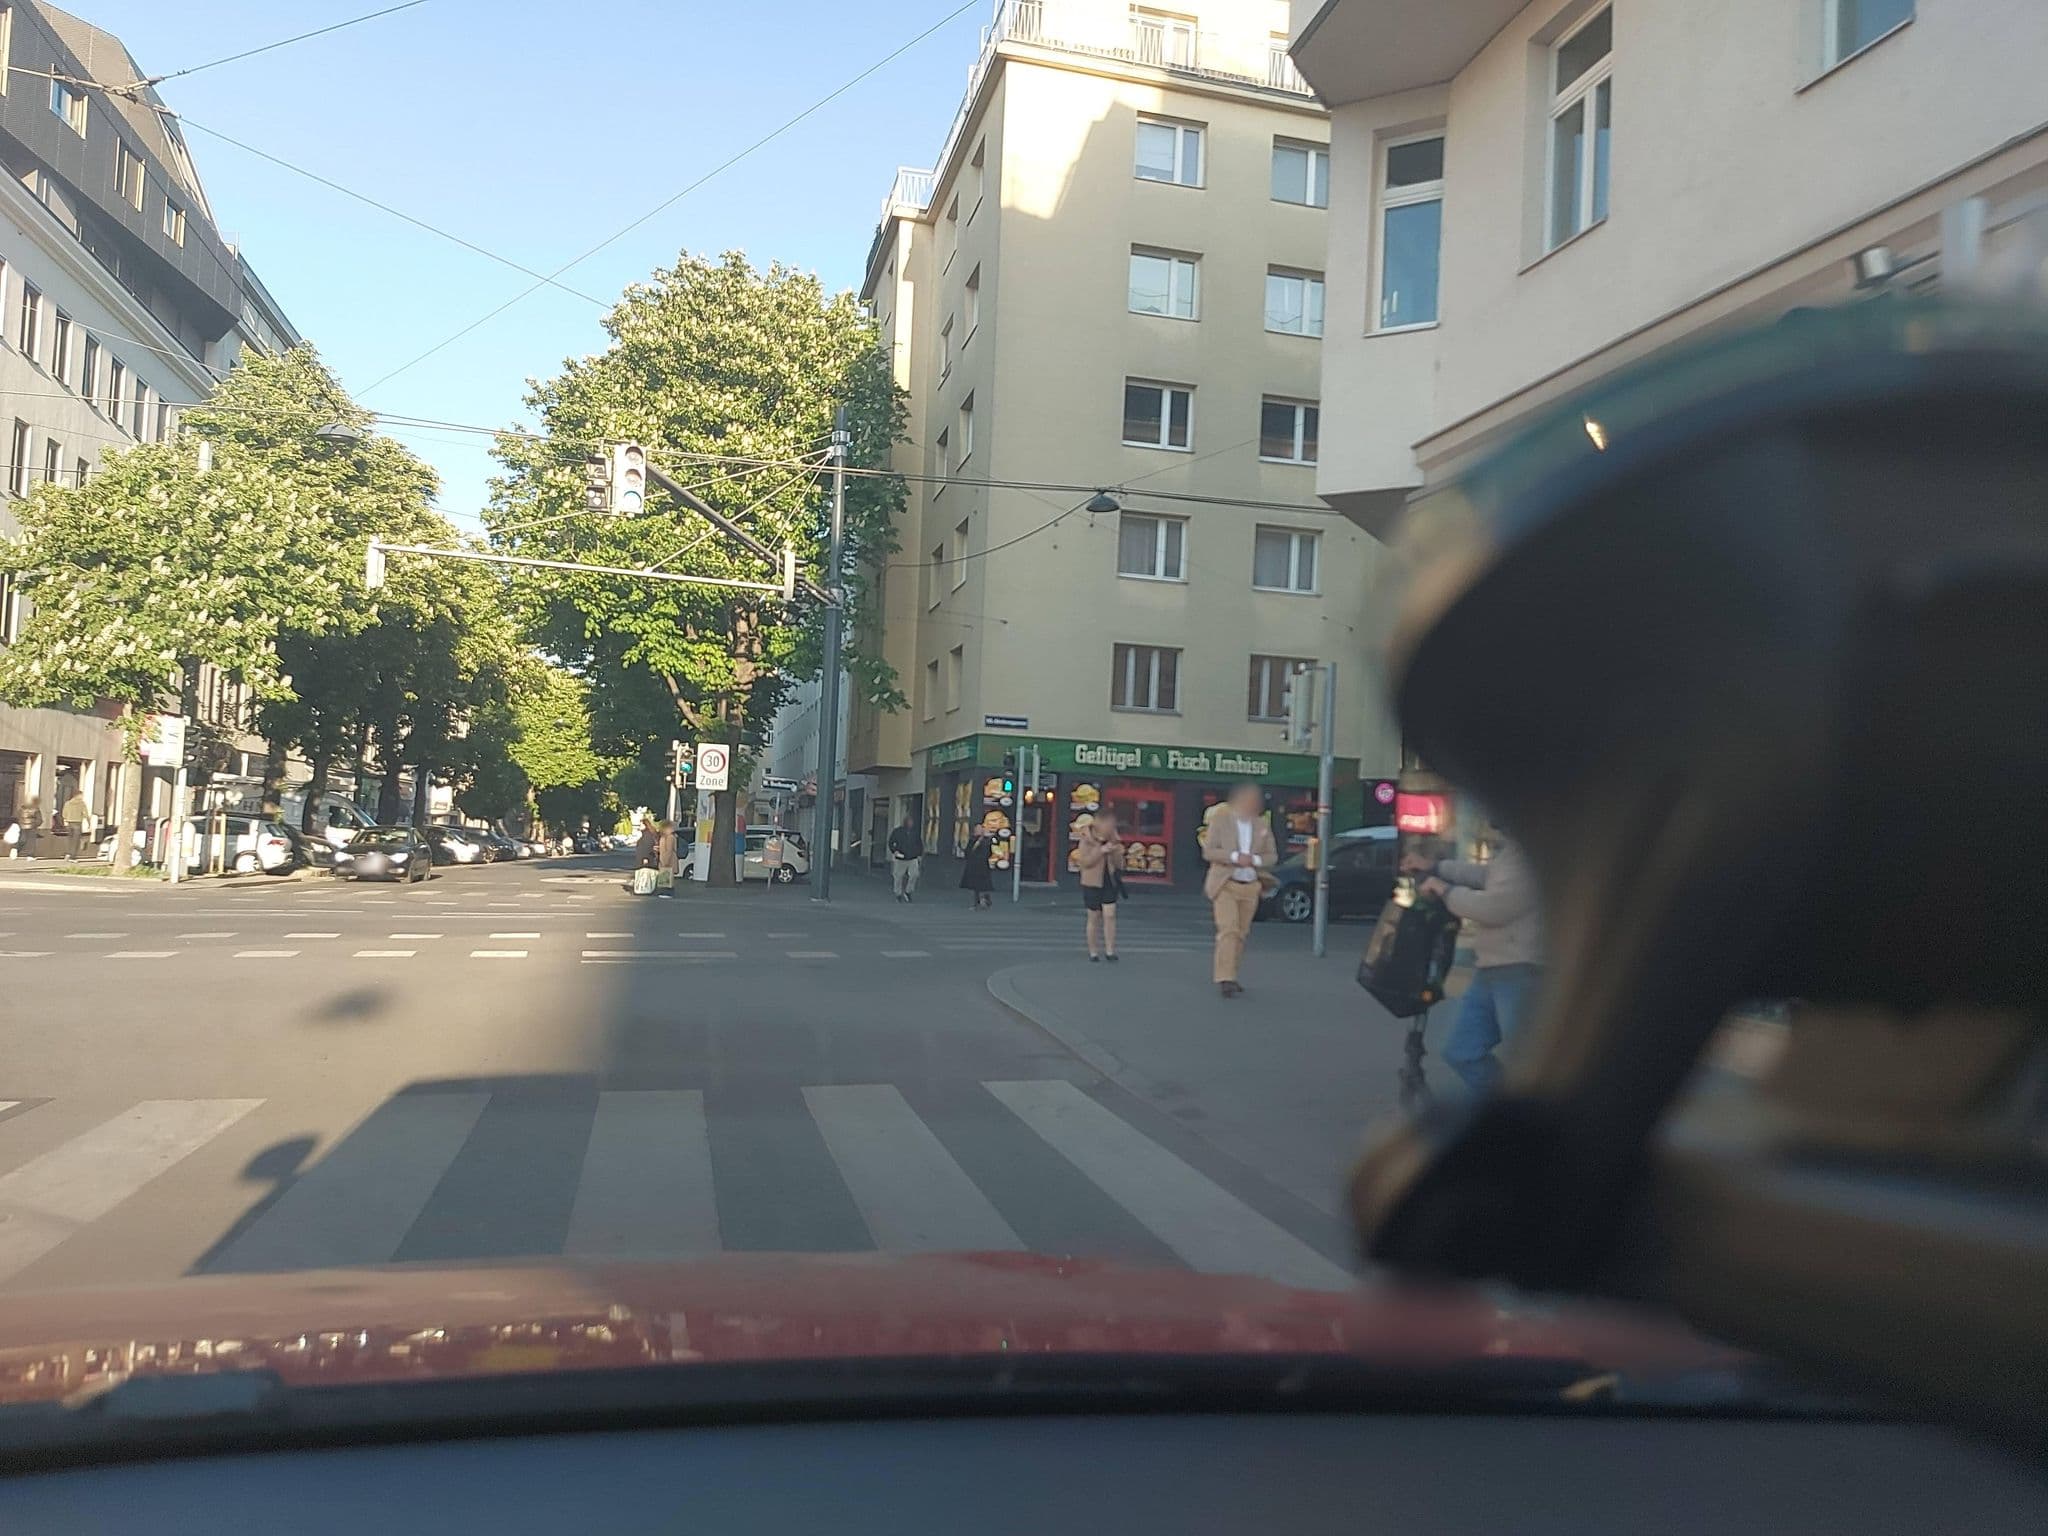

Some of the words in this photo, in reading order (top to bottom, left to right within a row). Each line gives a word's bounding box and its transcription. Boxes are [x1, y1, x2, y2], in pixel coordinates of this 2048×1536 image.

[706, 755, 719, 767] 30
[1075, 744, 1141, 770] Geflügel
[1168, 750, 1210, 771] Fisch
[1215, 753, 1268, 775] Imbiss
[700, 775, 724, 786] Zone
